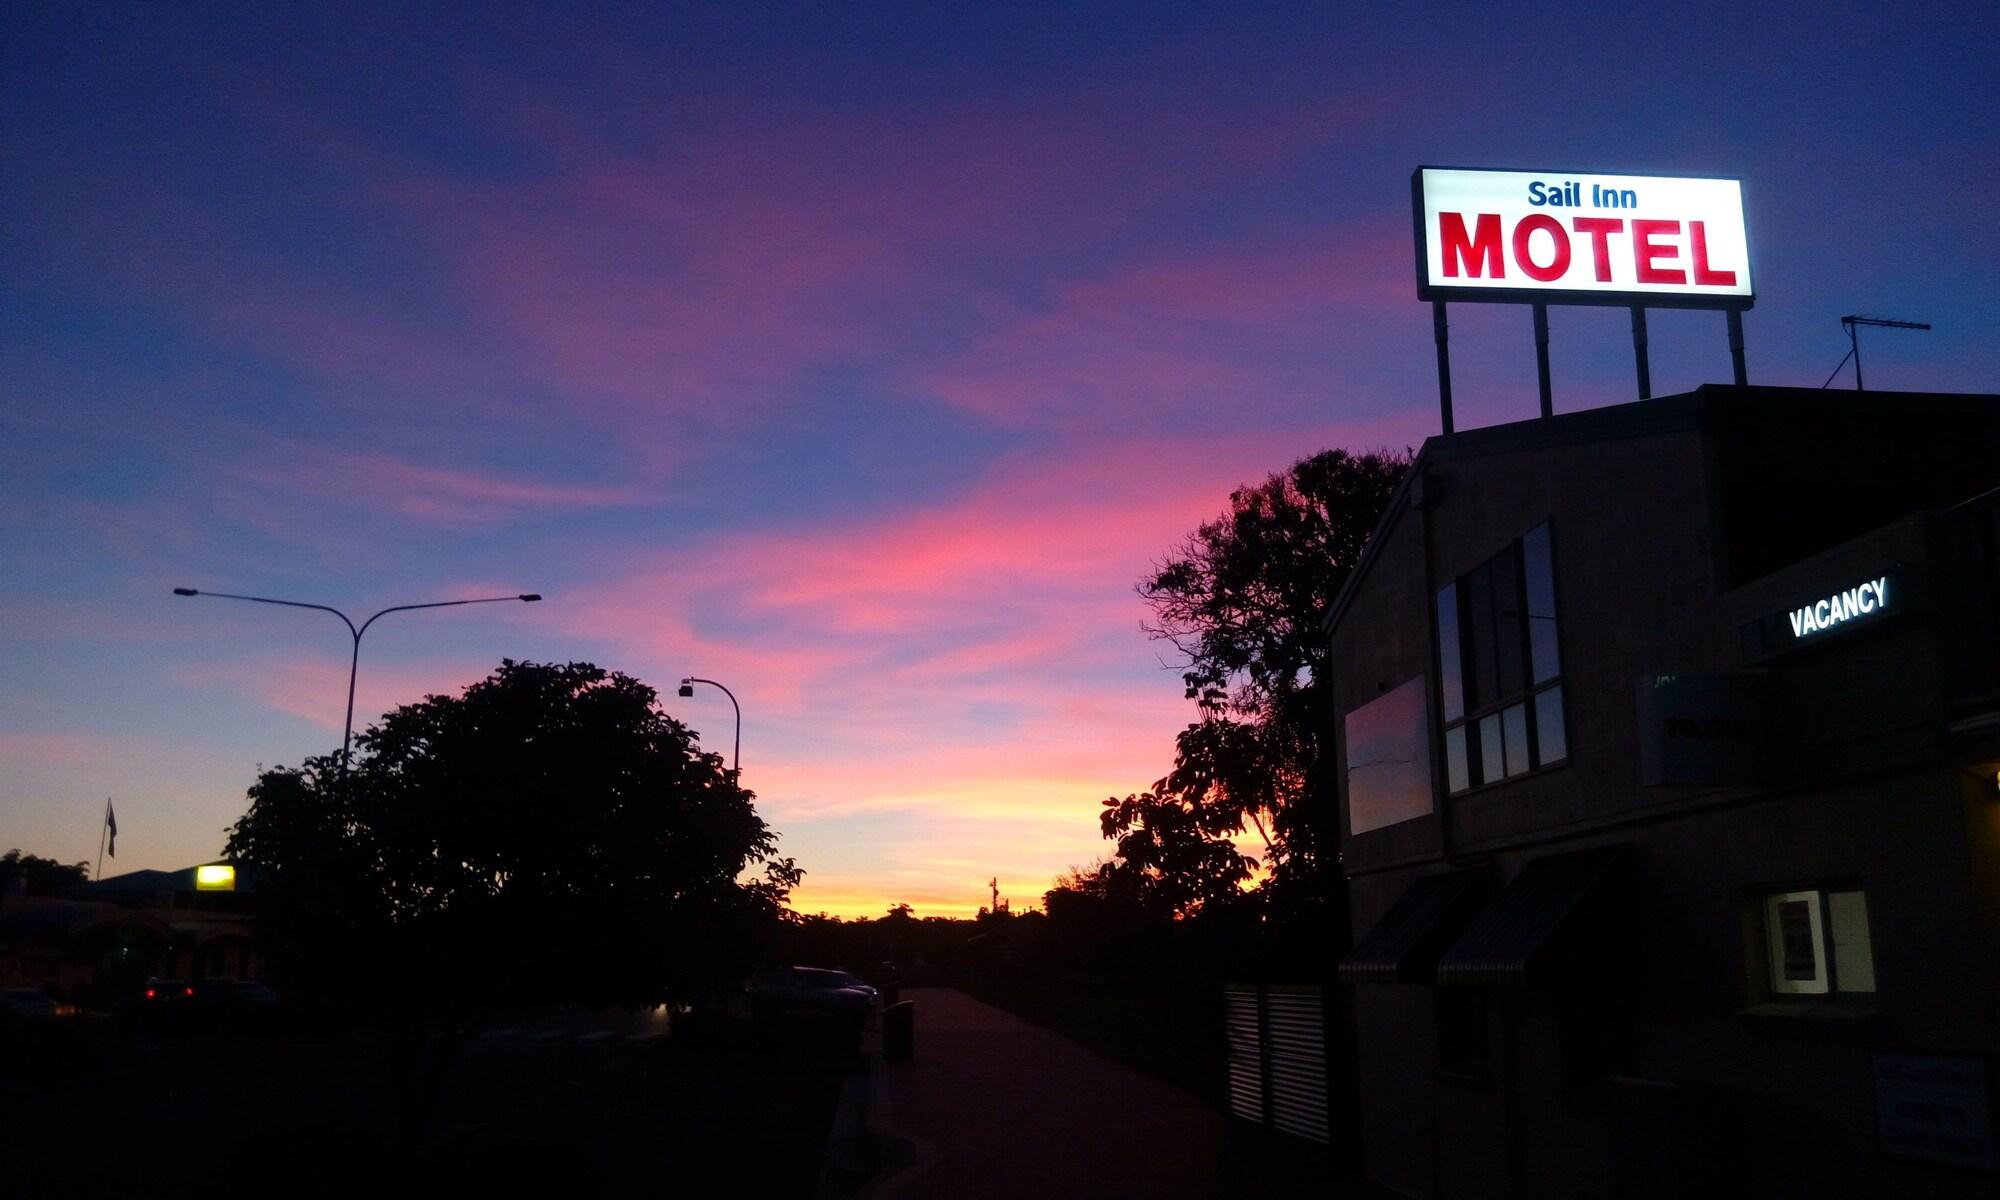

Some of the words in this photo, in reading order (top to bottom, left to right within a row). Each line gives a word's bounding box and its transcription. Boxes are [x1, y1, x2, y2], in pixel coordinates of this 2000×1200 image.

[1528, 181, 1581, 207] Sail
[1592, 184, 1637, 209] Inn
[1439, 212, 1737, 286] MOTEL
[1789, 577, 1886, 637] VACANCY
